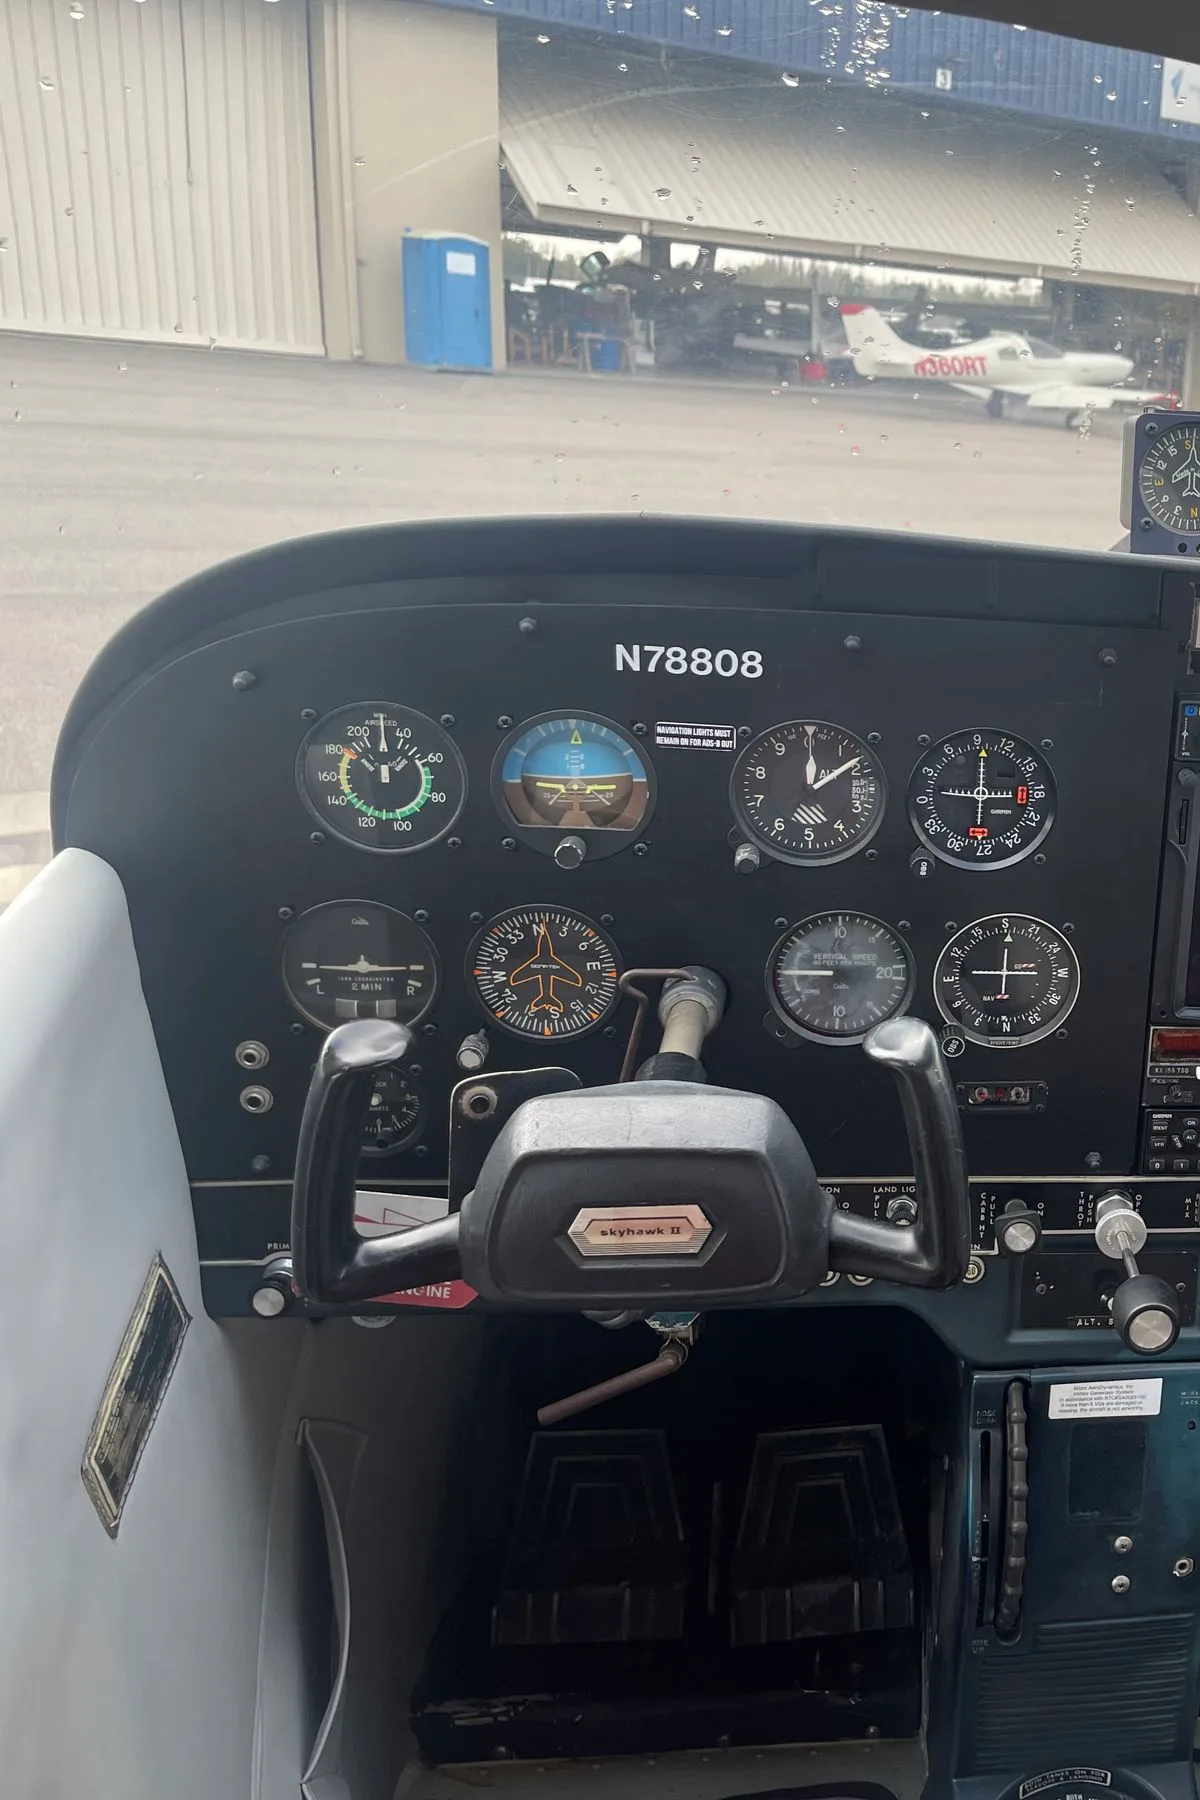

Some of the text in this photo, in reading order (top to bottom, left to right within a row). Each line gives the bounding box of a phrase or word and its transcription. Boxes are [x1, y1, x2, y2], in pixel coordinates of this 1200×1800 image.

[1167, 445, 1178, 457] 15
[1157, 460, 1167, 471] 12
[615, 643, 764, 678] N78808
[347, 726, 370, 737] 200
[396, 728, 411, 738] 40
[656, 726, 731, 737] NAVIGATION LIGHTS MUST
[656, 736, 679, 745] REMAIN
[690, 738, 701, 746] FOR
[702, 739, 720, 747] ADS-B
[721, 740, 733, 748] OUT
[973, 734, 982, 745] 9
[1000, 737, 1015, 751] 12
[326, 744, 343, 754] 180
[775, 743, 785, 755] 9
[427, 753, 443, 763] 60
[318, 772, 337, 782] 160
[755, 766, 766, 779] 8
[327, 795, 347, 805] 140
[431, 792, 446, 802] 80
[754, 795, 764, 807] 7
[852, 800, 861, 813] 3
[358, 817, 376, 827] 120
[394, 821, 412, 831] 100
[774, 818, 785, 831] 6
[834, 820, 844, 832] 4
[804, 828, 814, 841] 5
[506, 929, 524, 945] 33
[834, 926, 847, 938] 10
[493, 947, 509, 963] 30
[876, 967, 893, 979] 20
[501, 988, 518, 1003] 24
[833, 1005, 845, 1017] 10
[947, 1039, 959, 1053] OBS
[1037, 1202, 1044, 1216] ON
[1077, 1191, 1085, 1227] THROT
[600, 1226, 681, 1238] skyhawk II
[979, 1224, 985, 1238] HT
[1076, 1318, 1100, 1326] ALT.
